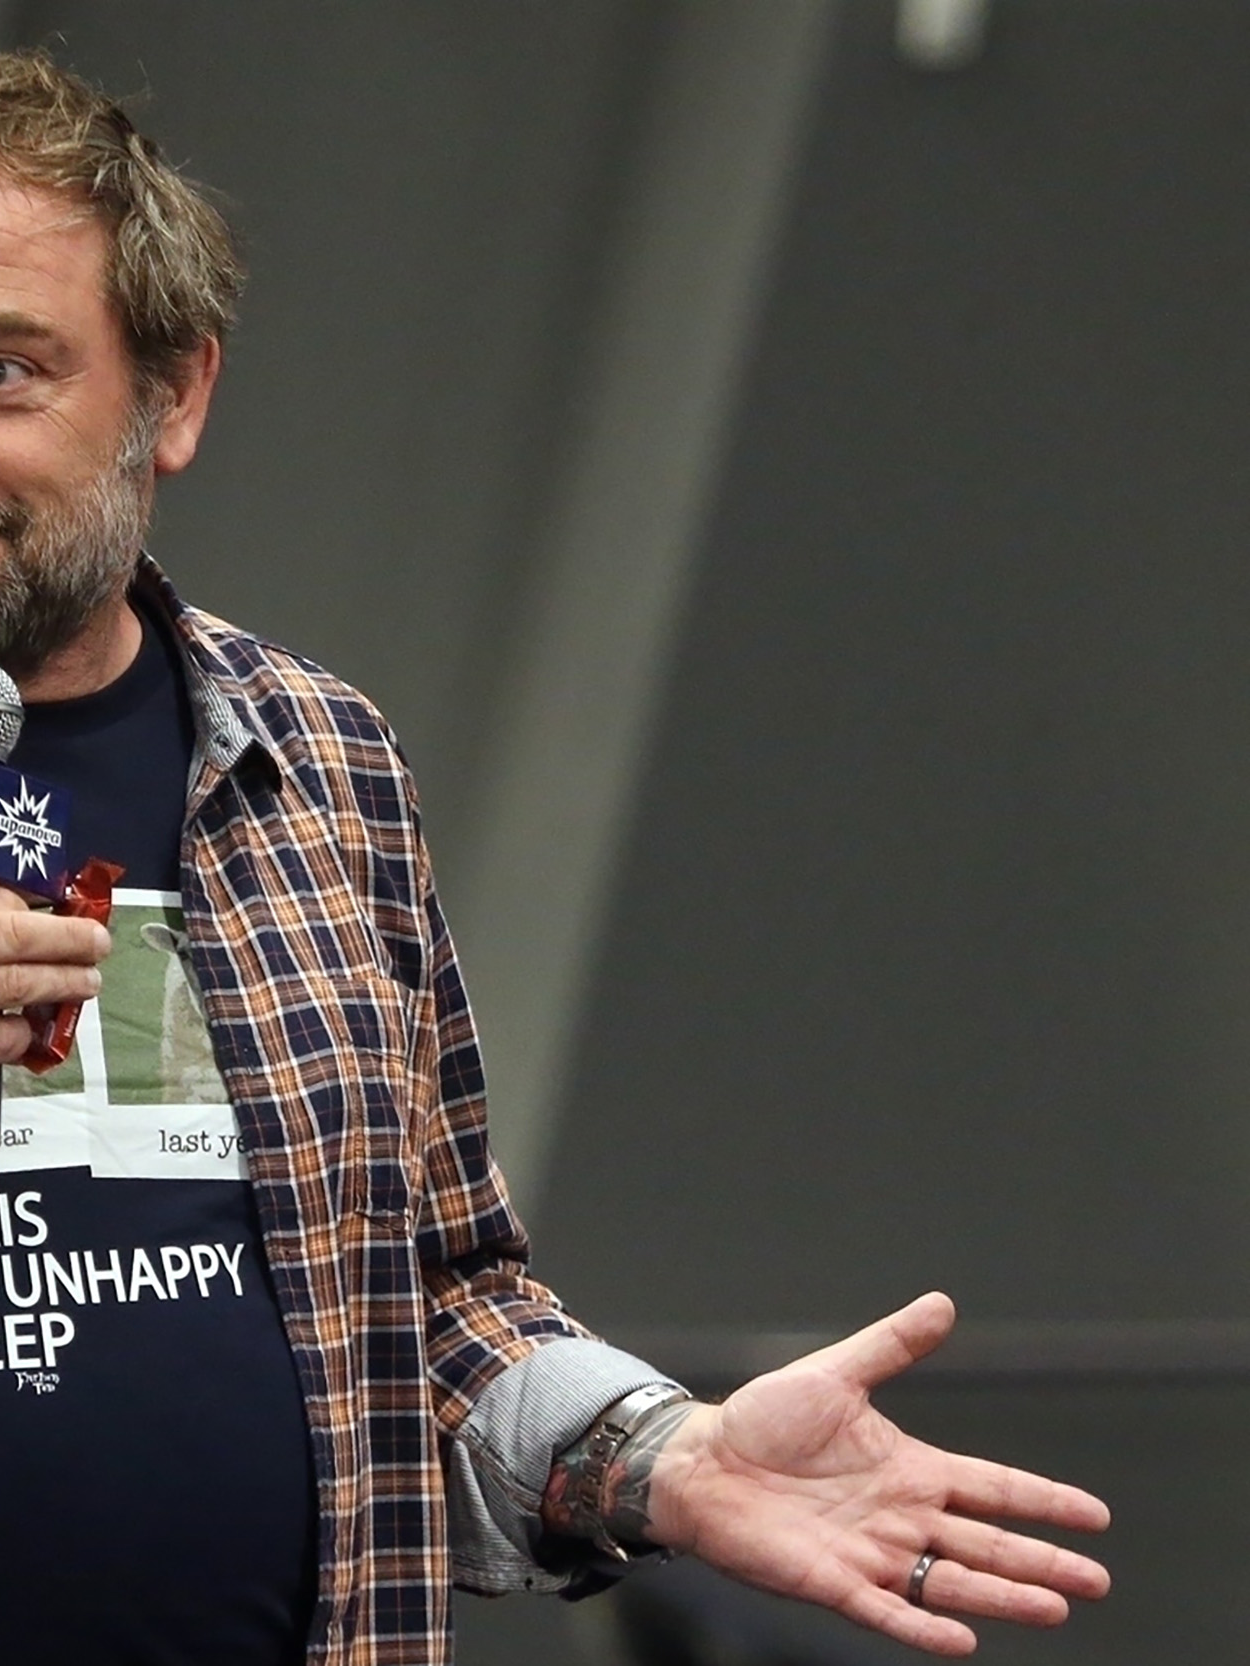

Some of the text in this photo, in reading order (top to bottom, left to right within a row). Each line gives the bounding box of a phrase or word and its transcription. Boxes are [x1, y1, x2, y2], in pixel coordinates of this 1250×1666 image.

[0, 1127, 34, 1147] ar
[158, 1129, 248, 1159] last ye
[1, 1243, 245, 1308] UNHAPPY
